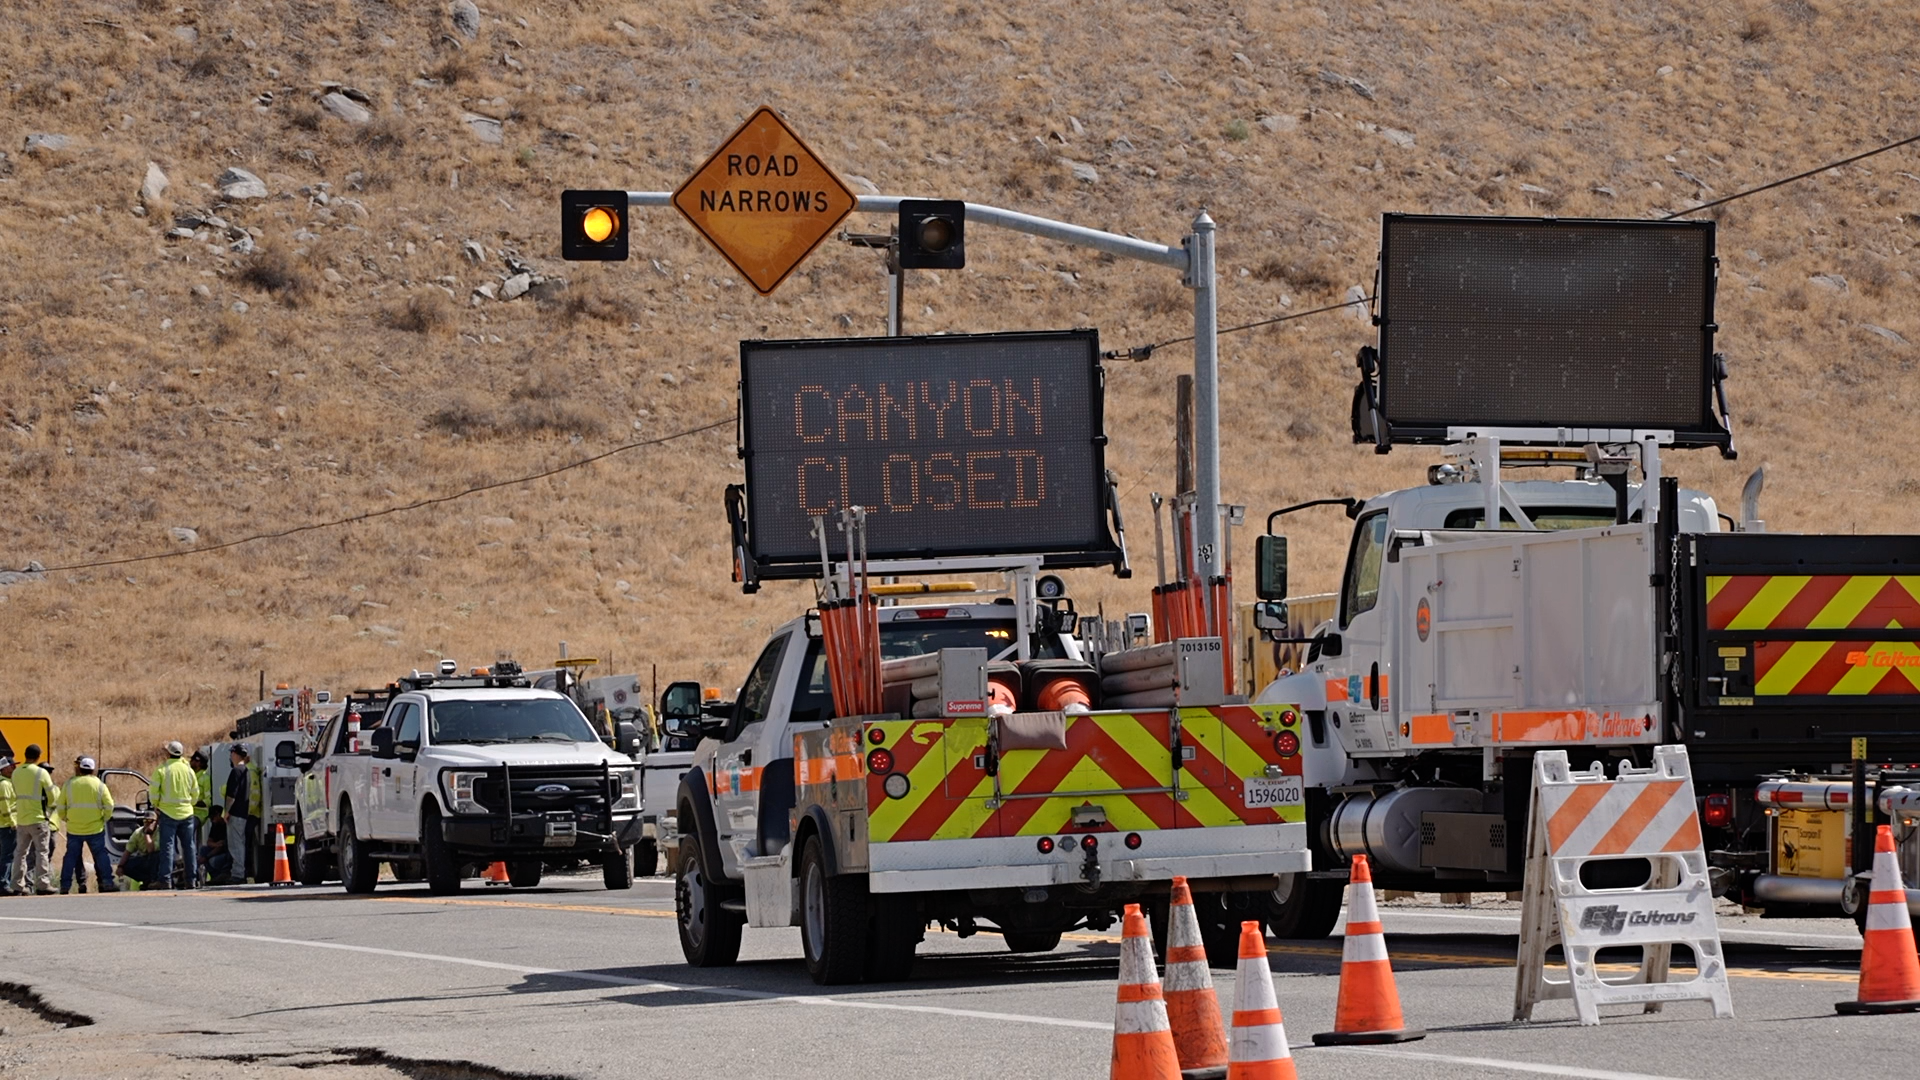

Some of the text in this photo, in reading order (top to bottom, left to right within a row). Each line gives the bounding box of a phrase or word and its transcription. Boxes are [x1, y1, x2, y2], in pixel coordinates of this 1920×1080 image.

[727, 154, 799, 177] ROAD
[700, 190, 829, 213] NARROWS
[794, 377, 1043, 443] CANYON
[797, 449, 1045, 516] CLOSED
[1180, 641, 1221, 653] 7013150
[948, 701, 982, 712] Supreme
[1249, 787, 1300, 804] 1596020
[1627, 910, 1698, 927] Caltrans
